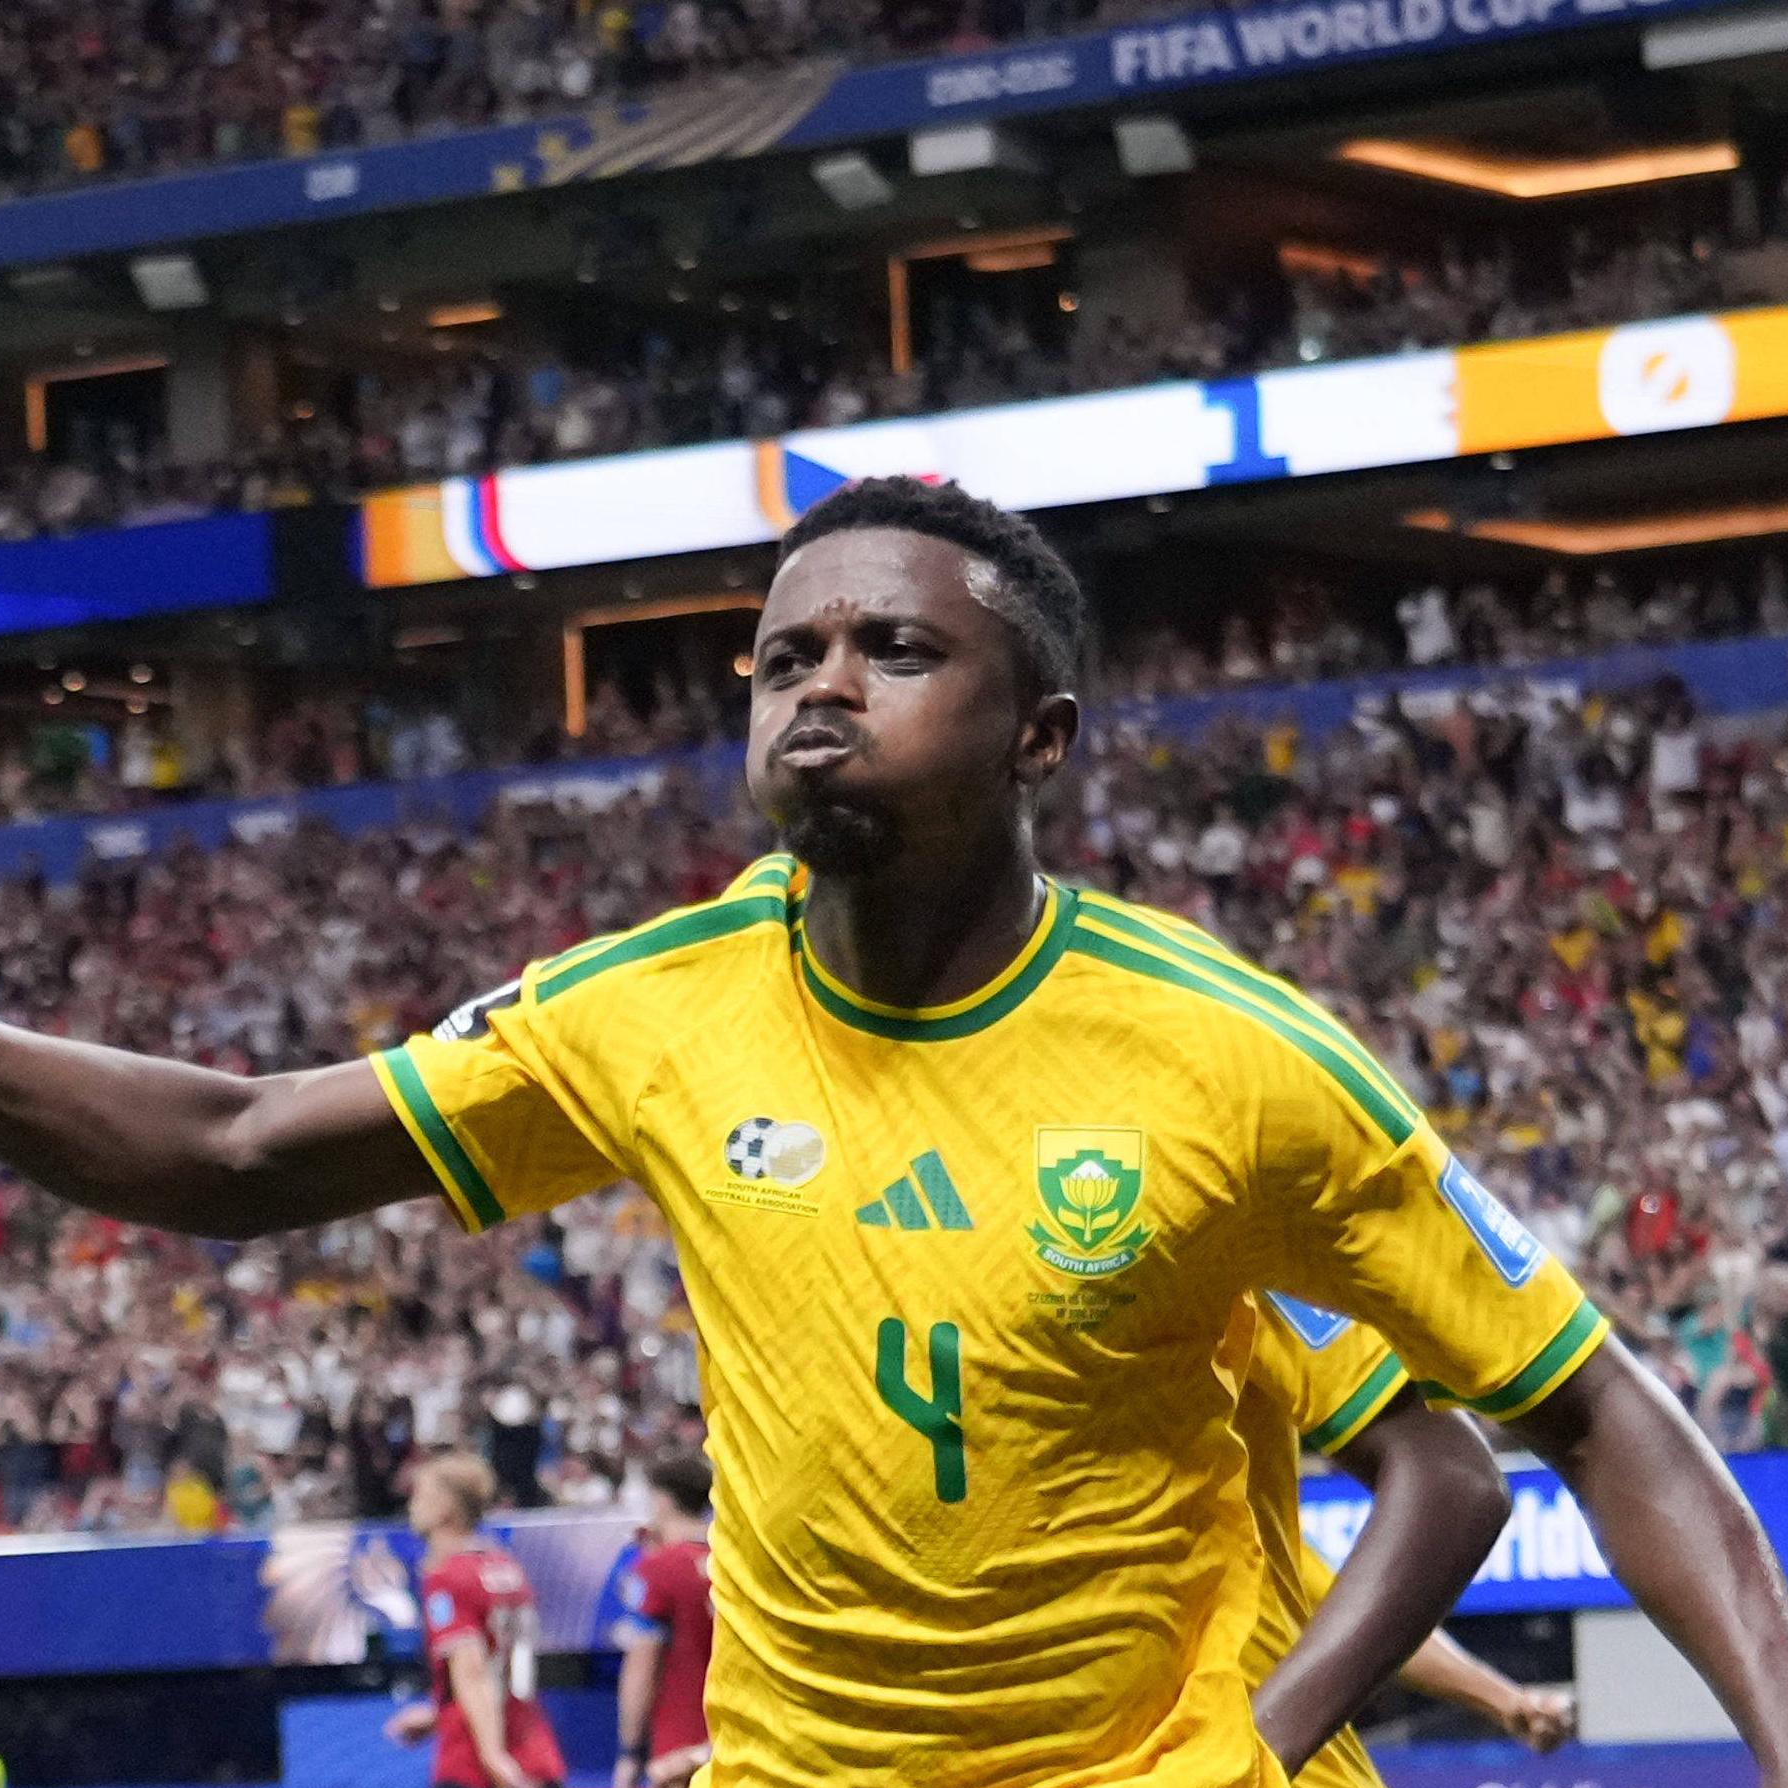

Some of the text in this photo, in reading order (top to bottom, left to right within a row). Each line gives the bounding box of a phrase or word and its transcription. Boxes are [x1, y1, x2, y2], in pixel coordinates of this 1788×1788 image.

[1112, 23, 1235, 86] FIFA
[1237, 0, 1445, 68] WORLD
[1042, 1248, 1130, 1274] SOUTH AFRICA
[876, 1316, 969, 1505] 4
